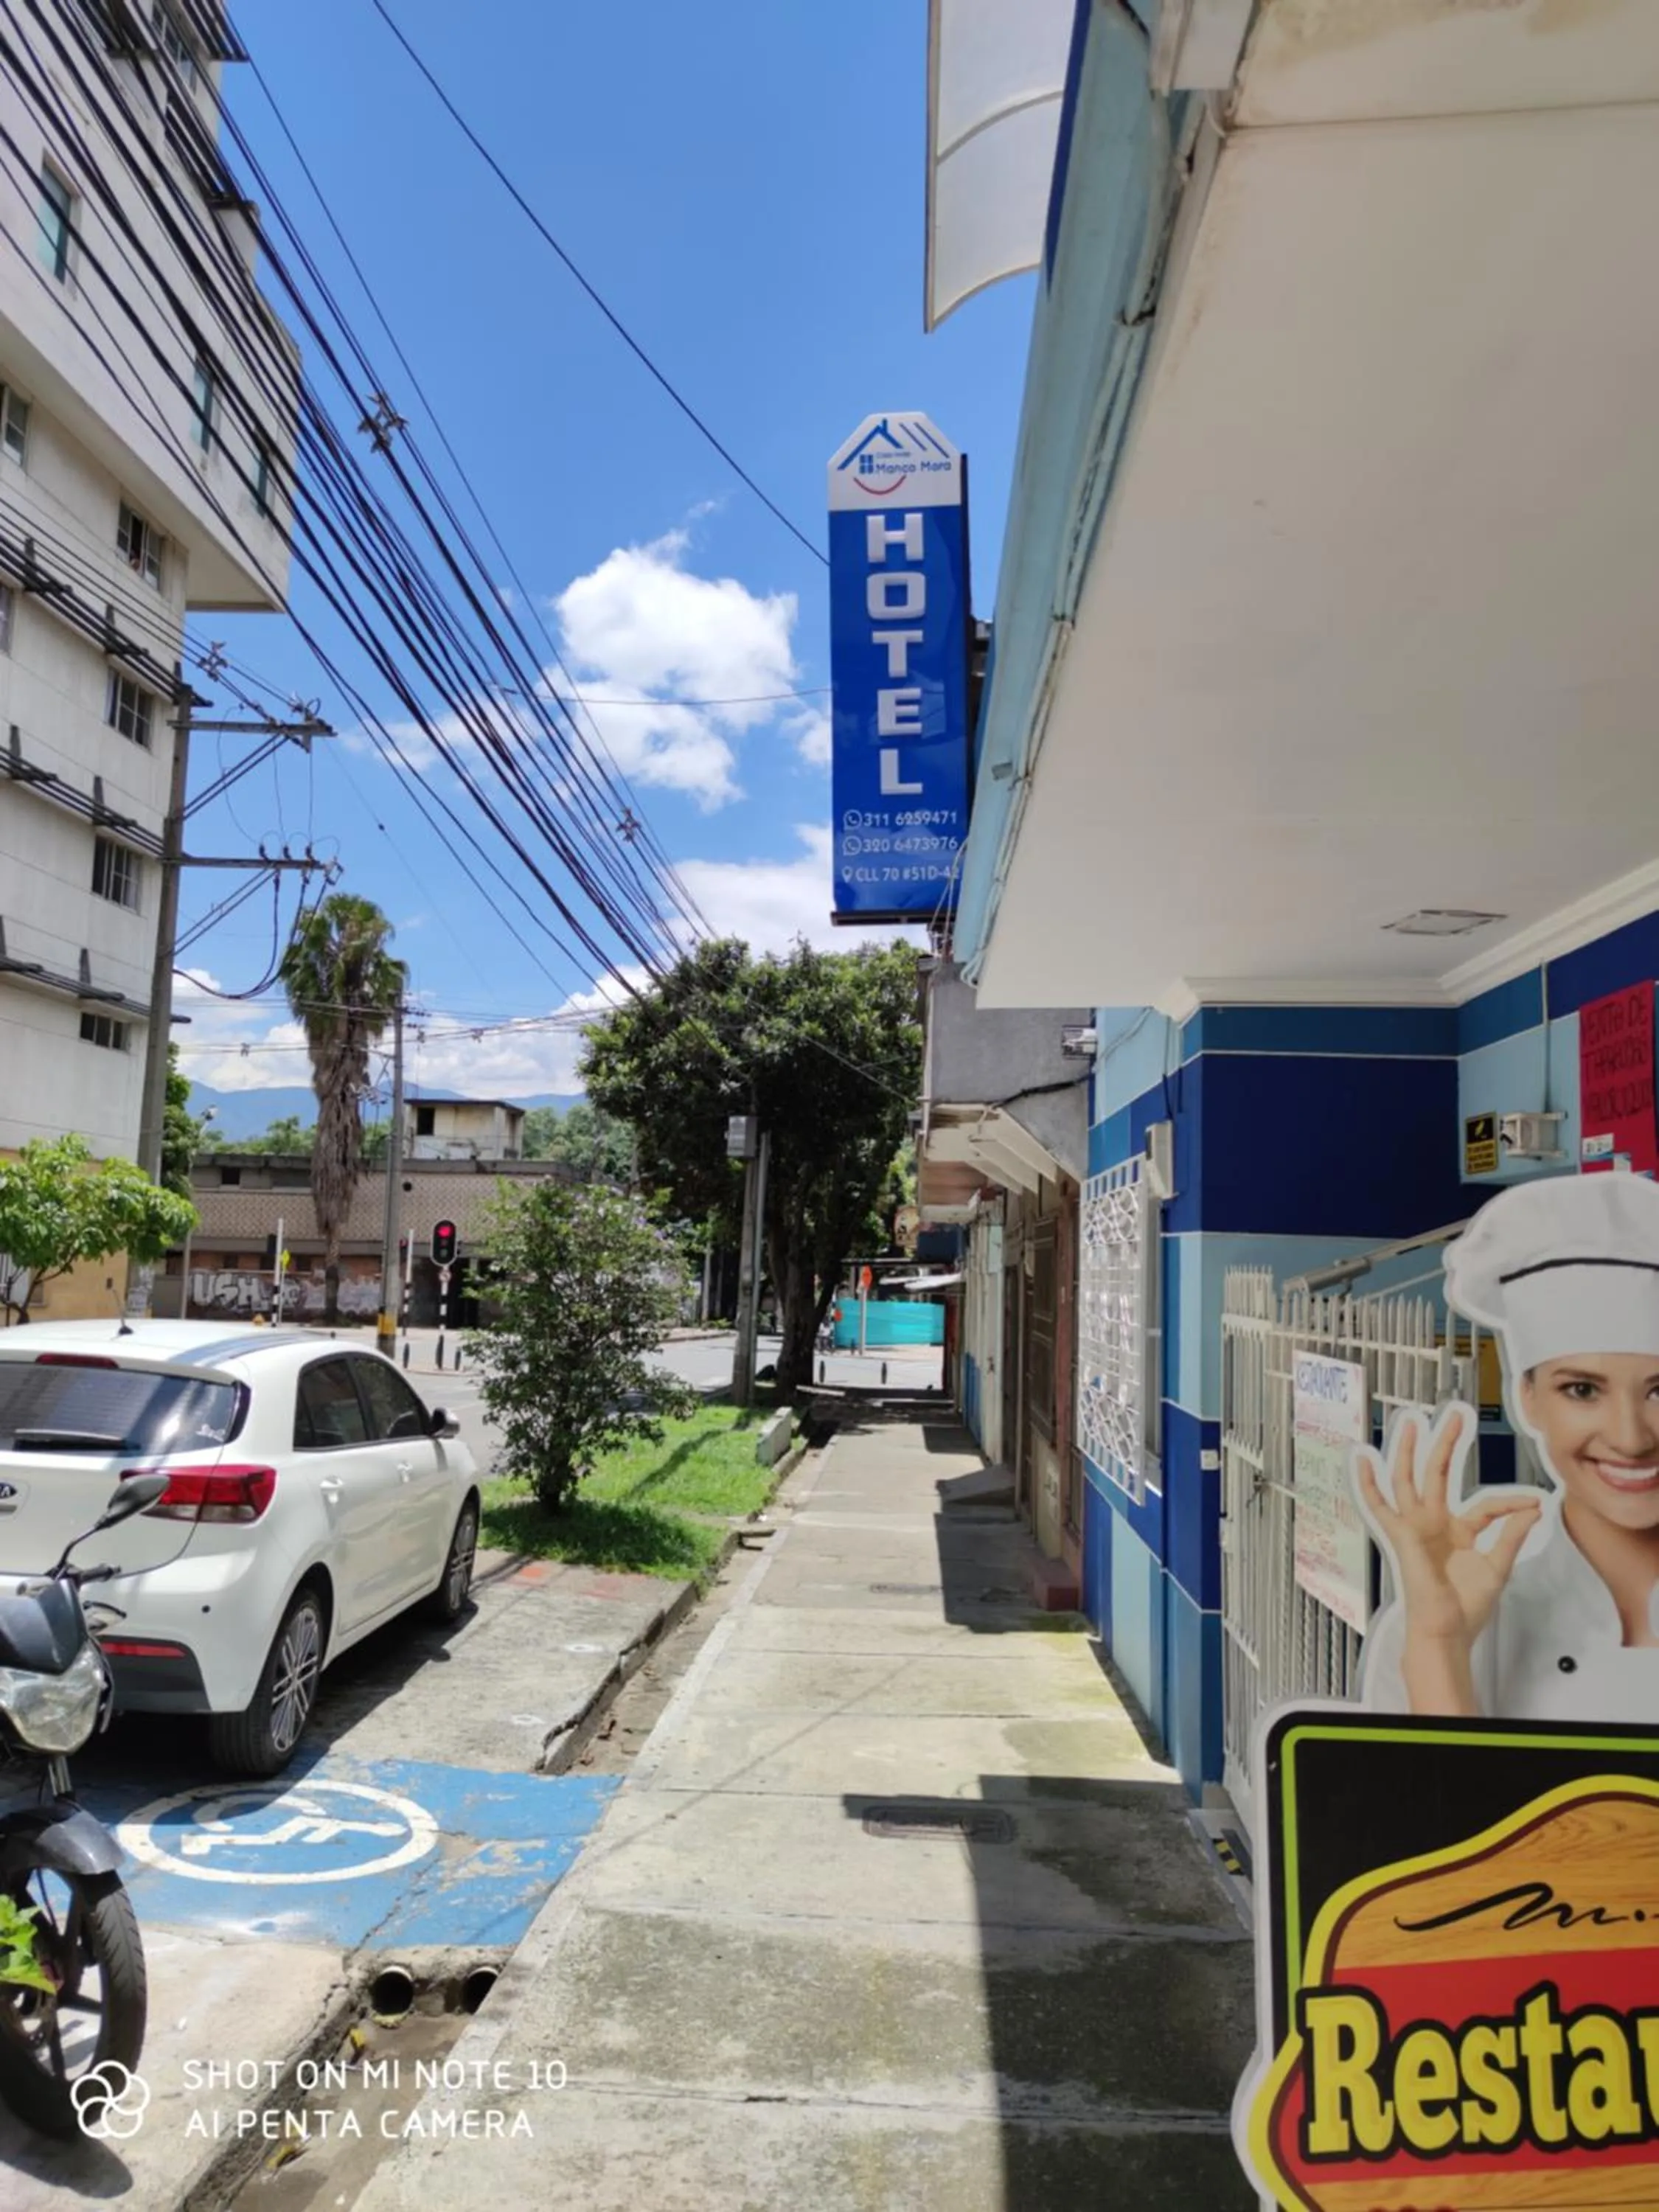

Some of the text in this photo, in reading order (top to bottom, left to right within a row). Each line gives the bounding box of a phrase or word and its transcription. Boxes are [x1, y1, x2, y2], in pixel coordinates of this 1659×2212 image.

[866, 512, 925, 796] HOTEL
[863, 810, 958, 827] 311 6259471
[863, 836, 958, 853] 320 6473976
[855, 869, 879, 883] CLL
[883, 868, 900, 881] 70
